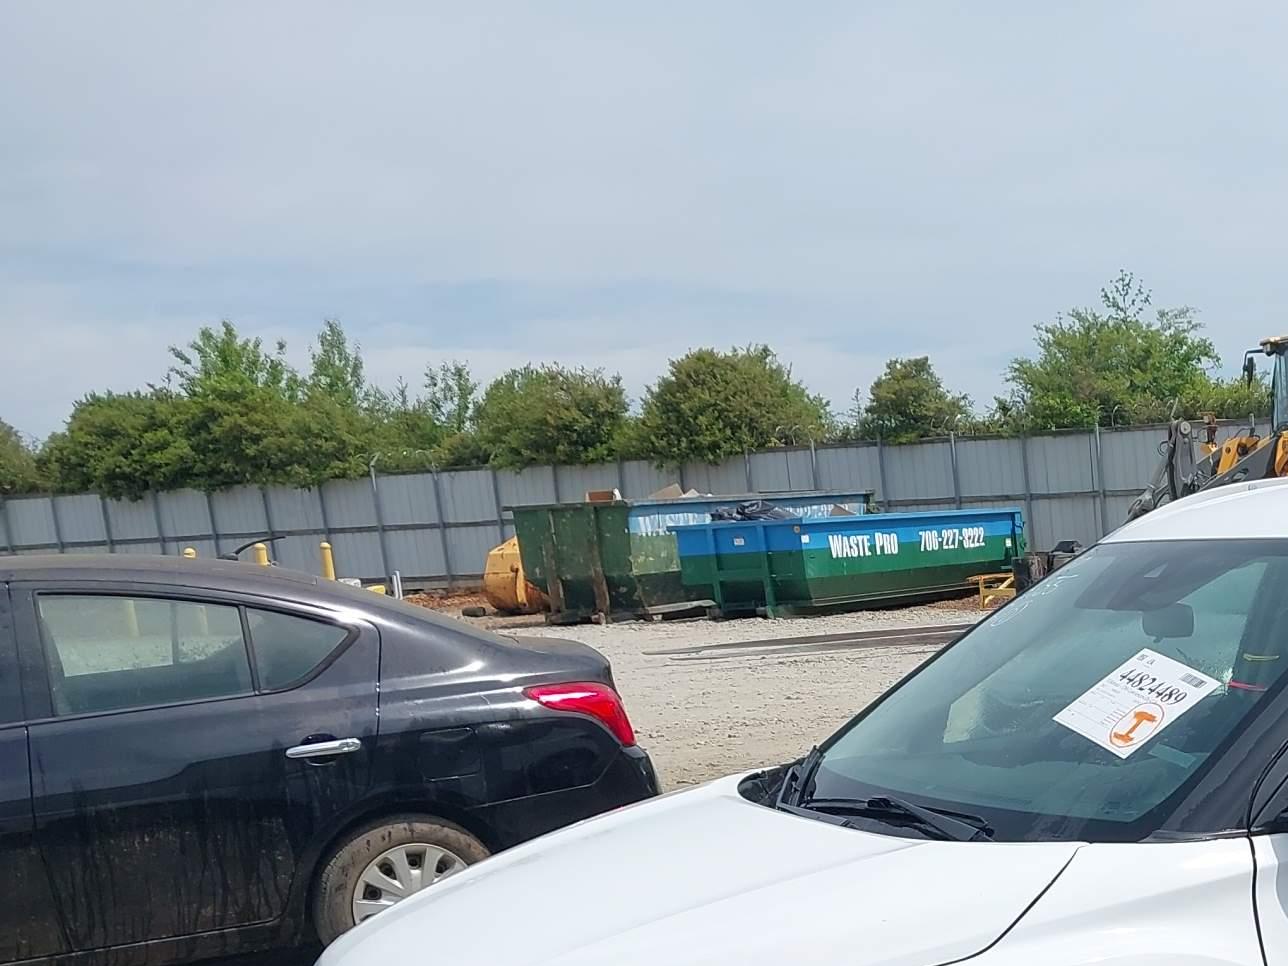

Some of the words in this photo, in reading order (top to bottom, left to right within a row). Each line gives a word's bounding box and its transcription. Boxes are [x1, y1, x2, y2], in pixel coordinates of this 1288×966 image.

[828, 533, 871, 559] WASTE
[874, 532, 899, 556] PRO
[918, 526, 985, 552] 706-227-3222
[1119, 668, 1188, 705] 44824489
